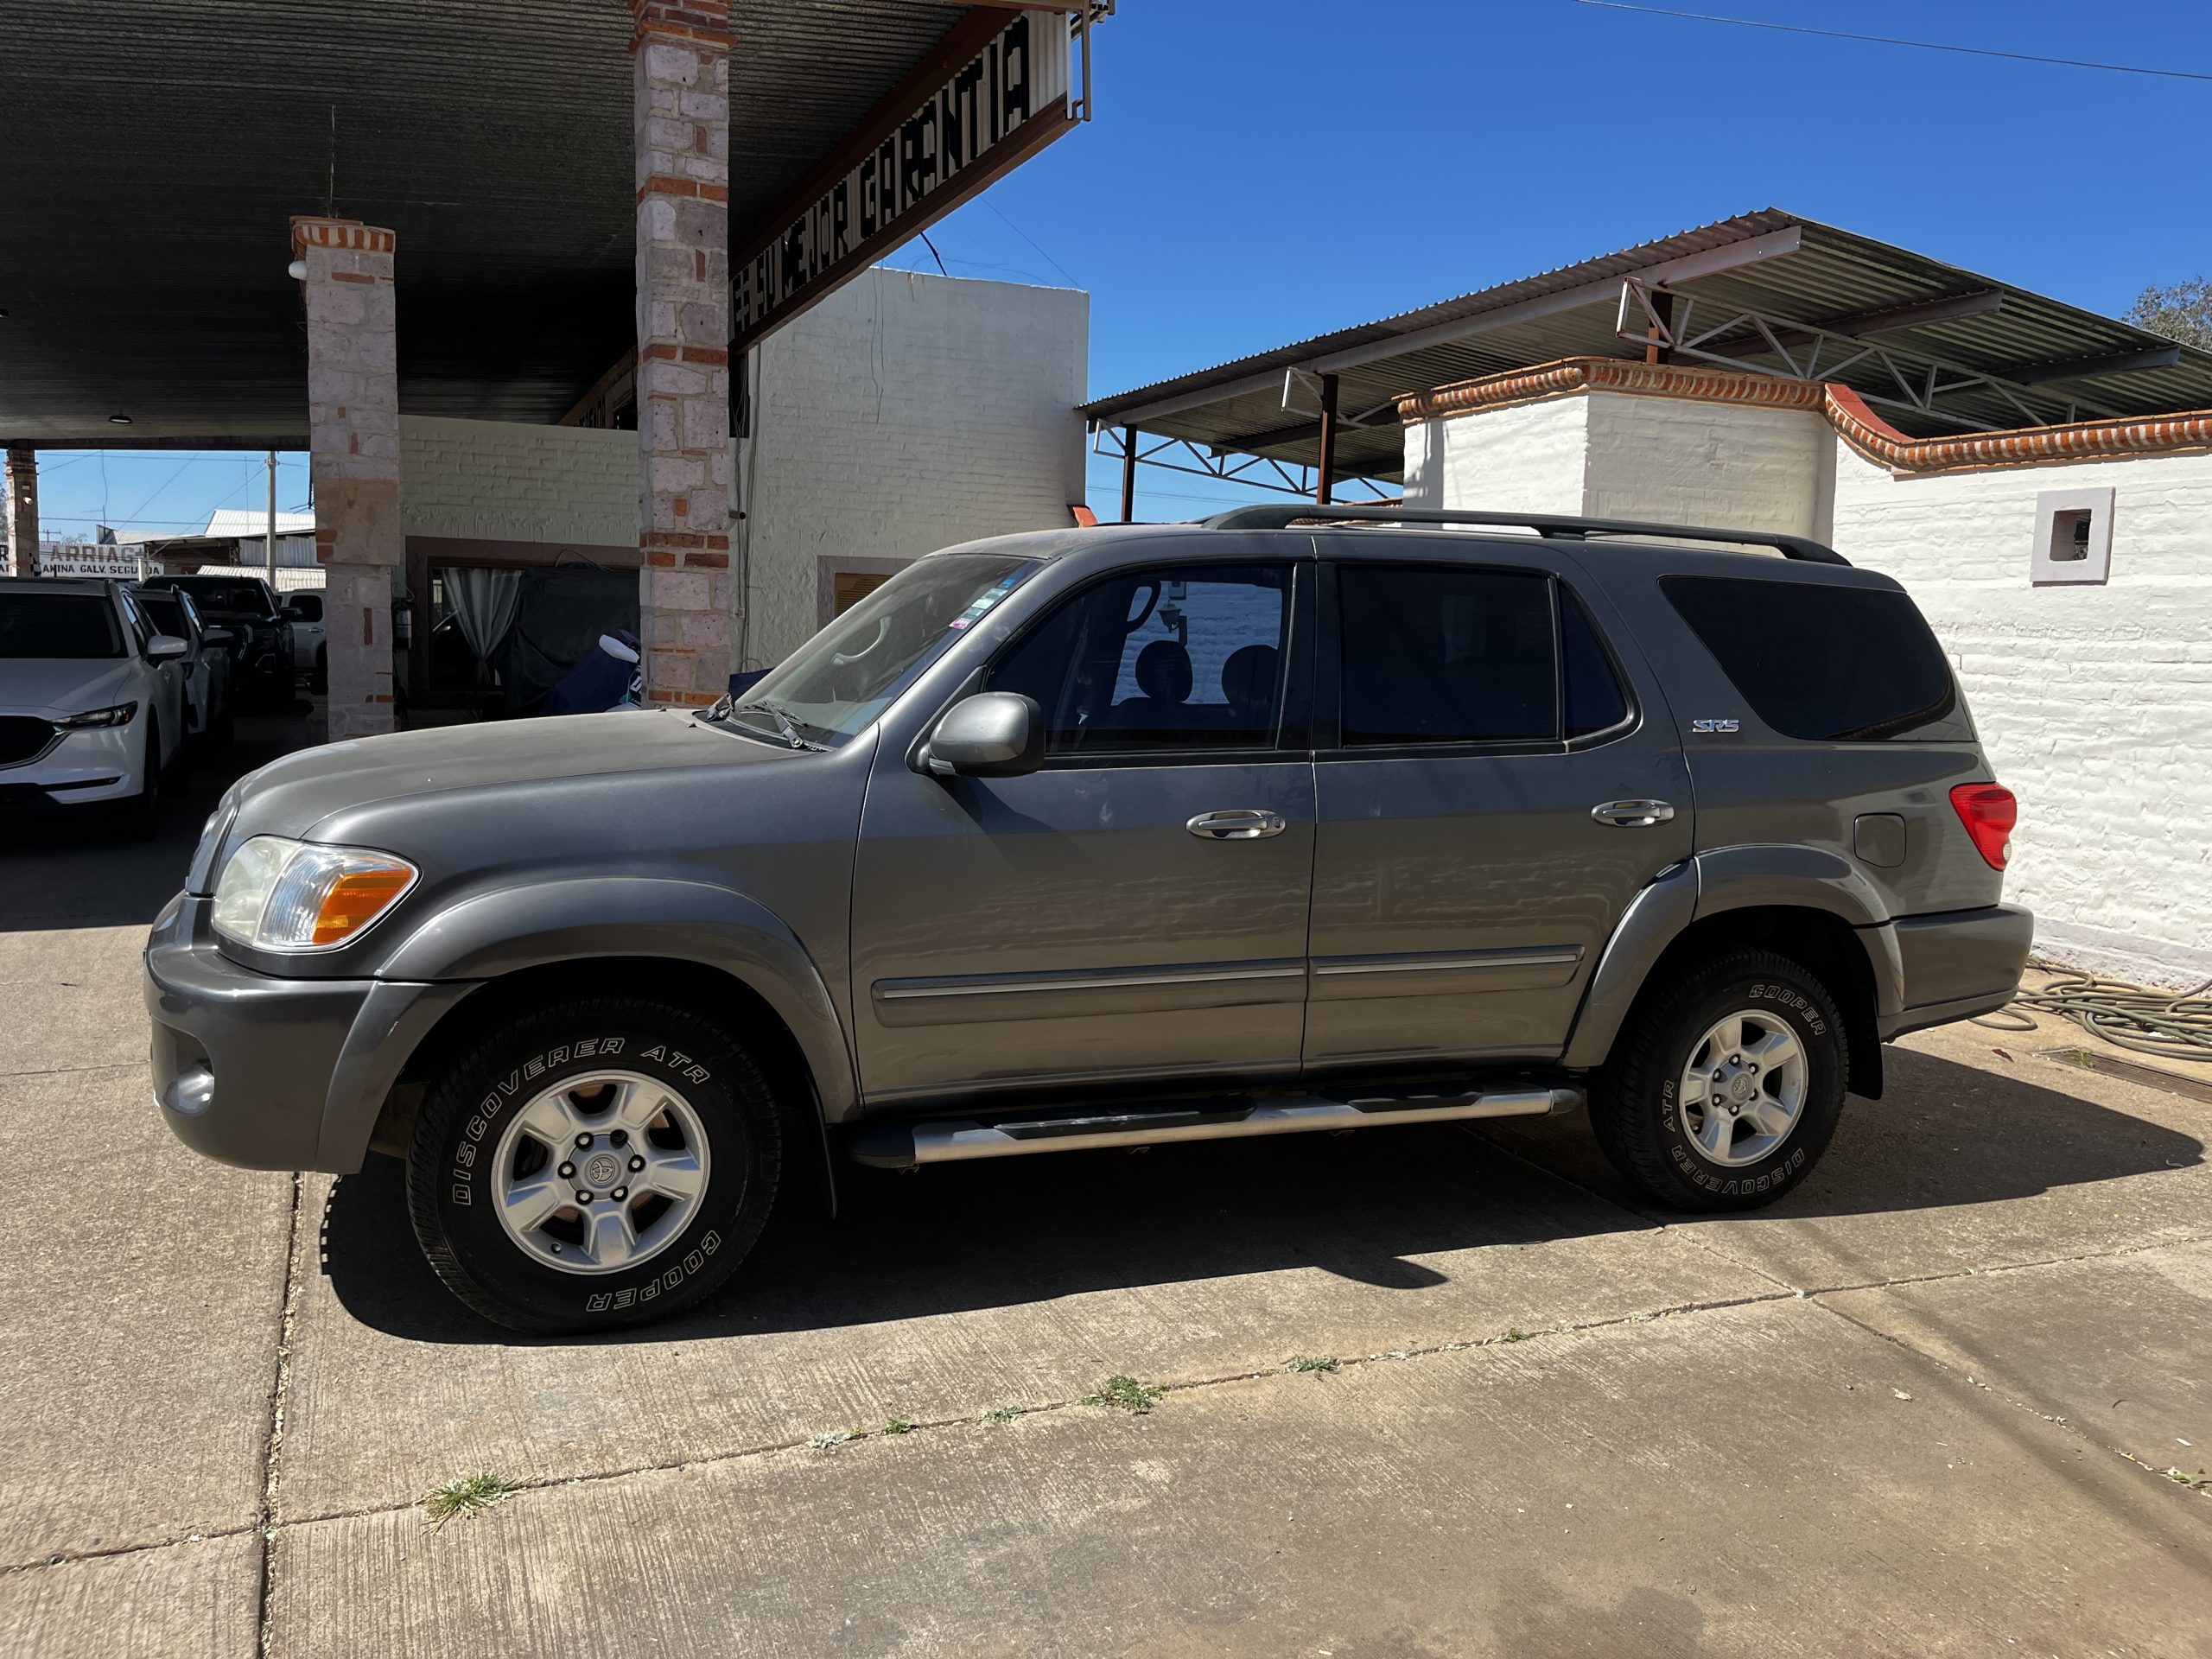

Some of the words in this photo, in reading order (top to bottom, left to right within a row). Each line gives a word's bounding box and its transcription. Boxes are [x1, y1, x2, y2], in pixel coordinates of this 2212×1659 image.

[781, 180, 849, 302] MEJOR
[861, 15, 1030, 240] GARANTIA
[110, 565, 160, 575] SEGUDA
[1693, 719, 1739, 733] SR5
[1748, 984, 1827, 1036] COOPER
[452, 1037, 626, 1206] DISCOVERER
[639, 1045, 711, 1084] ATR
[1662, 1079, 1676, 1133] ATR
[1671, 1144, 1805, 1195] DISCOVERER
[586, 1230, 721, 1312] COOPER
